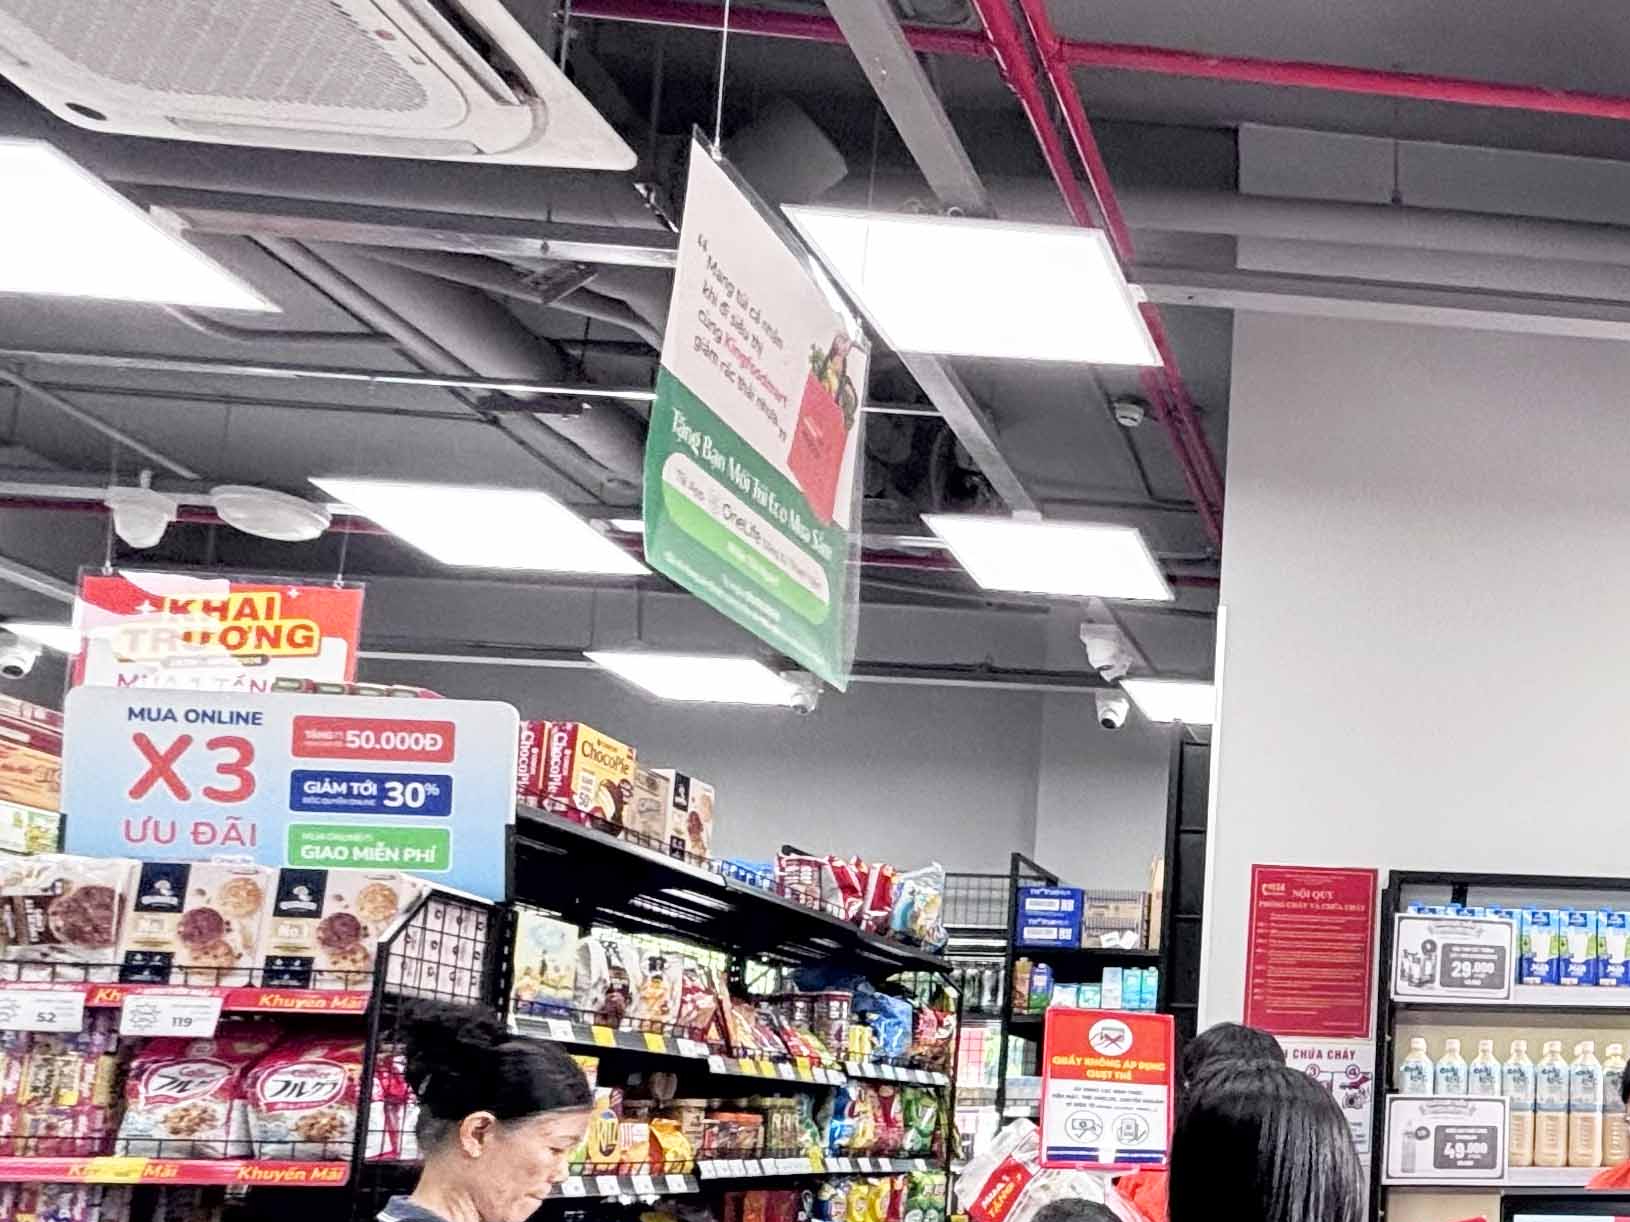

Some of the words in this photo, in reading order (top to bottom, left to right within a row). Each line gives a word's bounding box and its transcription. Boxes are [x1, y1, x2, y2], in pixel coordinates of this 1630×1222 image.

[169, 597, 277, 622] KHAI
[128, 706, 177, 722] MUA
[184, 708, 263, 726] ONLINE
[345, 730, 443, 751] 50.000Đ
[128, 732, 256, 803] X3
[581, 740, 630, 776] ChocoPie
[303, 777, 348, 795] GIẢM
[124, 818, 177, 845] ƯU
[190, 817, 257, 847] ĐÃI
[302, 845, 349, 861] GIAO
[403, 844, 437, 863] PHÍ
[36, 1011, 57, 1023] 52
[171, 1016, 193, 1028] 119
